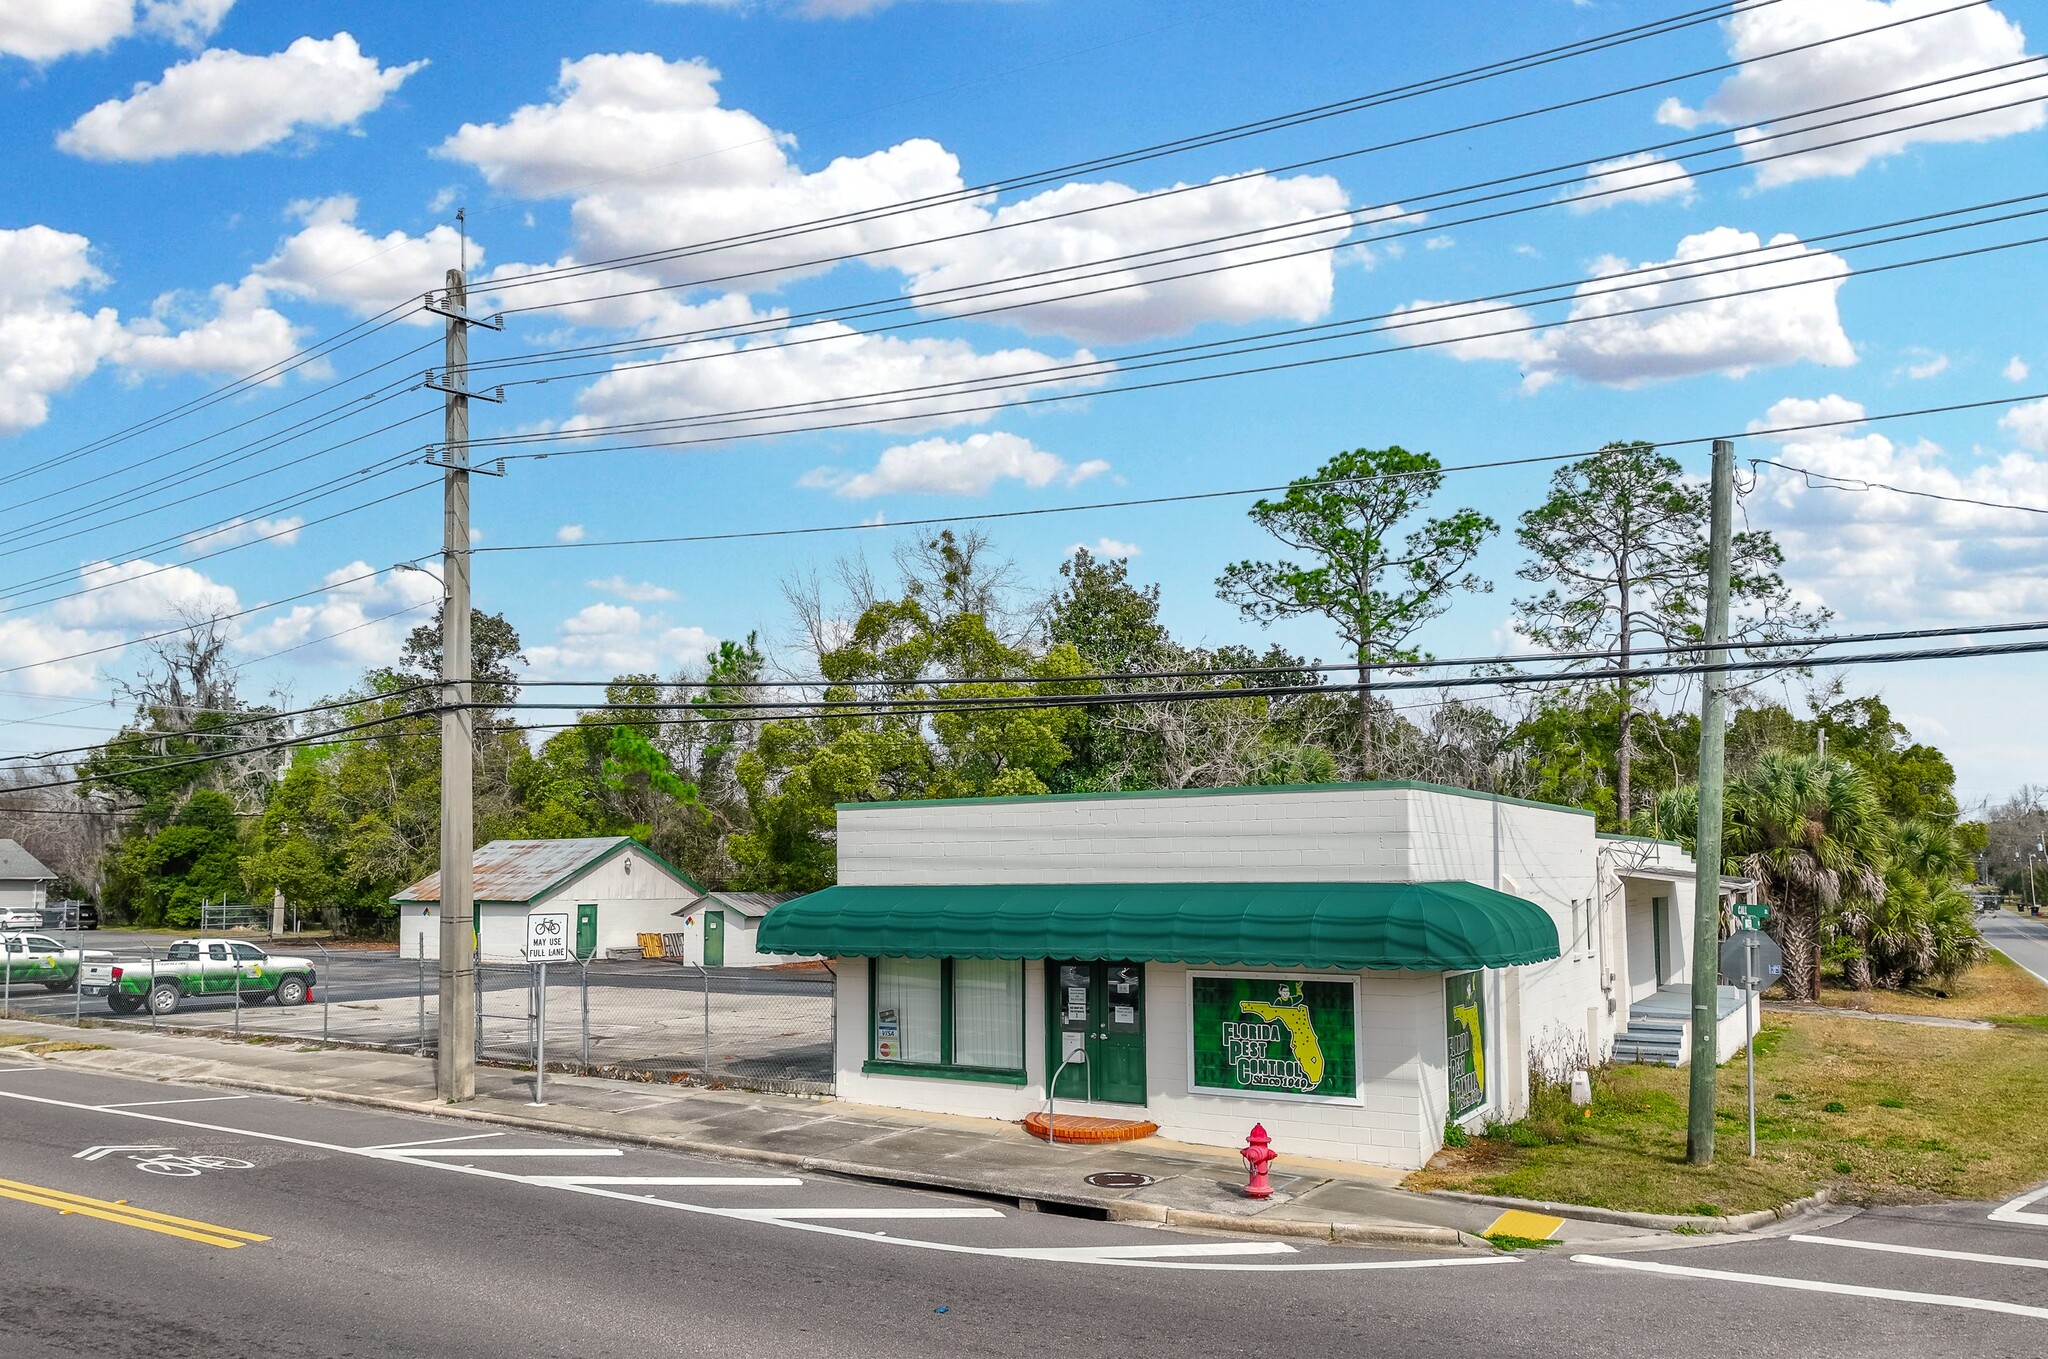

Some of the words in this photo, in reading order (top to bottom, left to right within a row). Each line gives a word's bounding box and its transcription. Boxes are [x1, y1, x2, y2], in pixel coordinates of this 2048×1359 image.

[533, 938, 547, 946] MAY
[549, 937, 562, 946] USE
[529, 949, 546, 957] FULL
[548, 948, 565, 956] LANE
[1222, 1022, 1280, 1046] FLORIDA
[1228, 1040, 1267, 1065] PEST
[1236, 1058, 1303, 1085] CONTROL
[1252, 1075, 1281, 1086] Since
[1281, 1077, 1308, 1089] 1949
